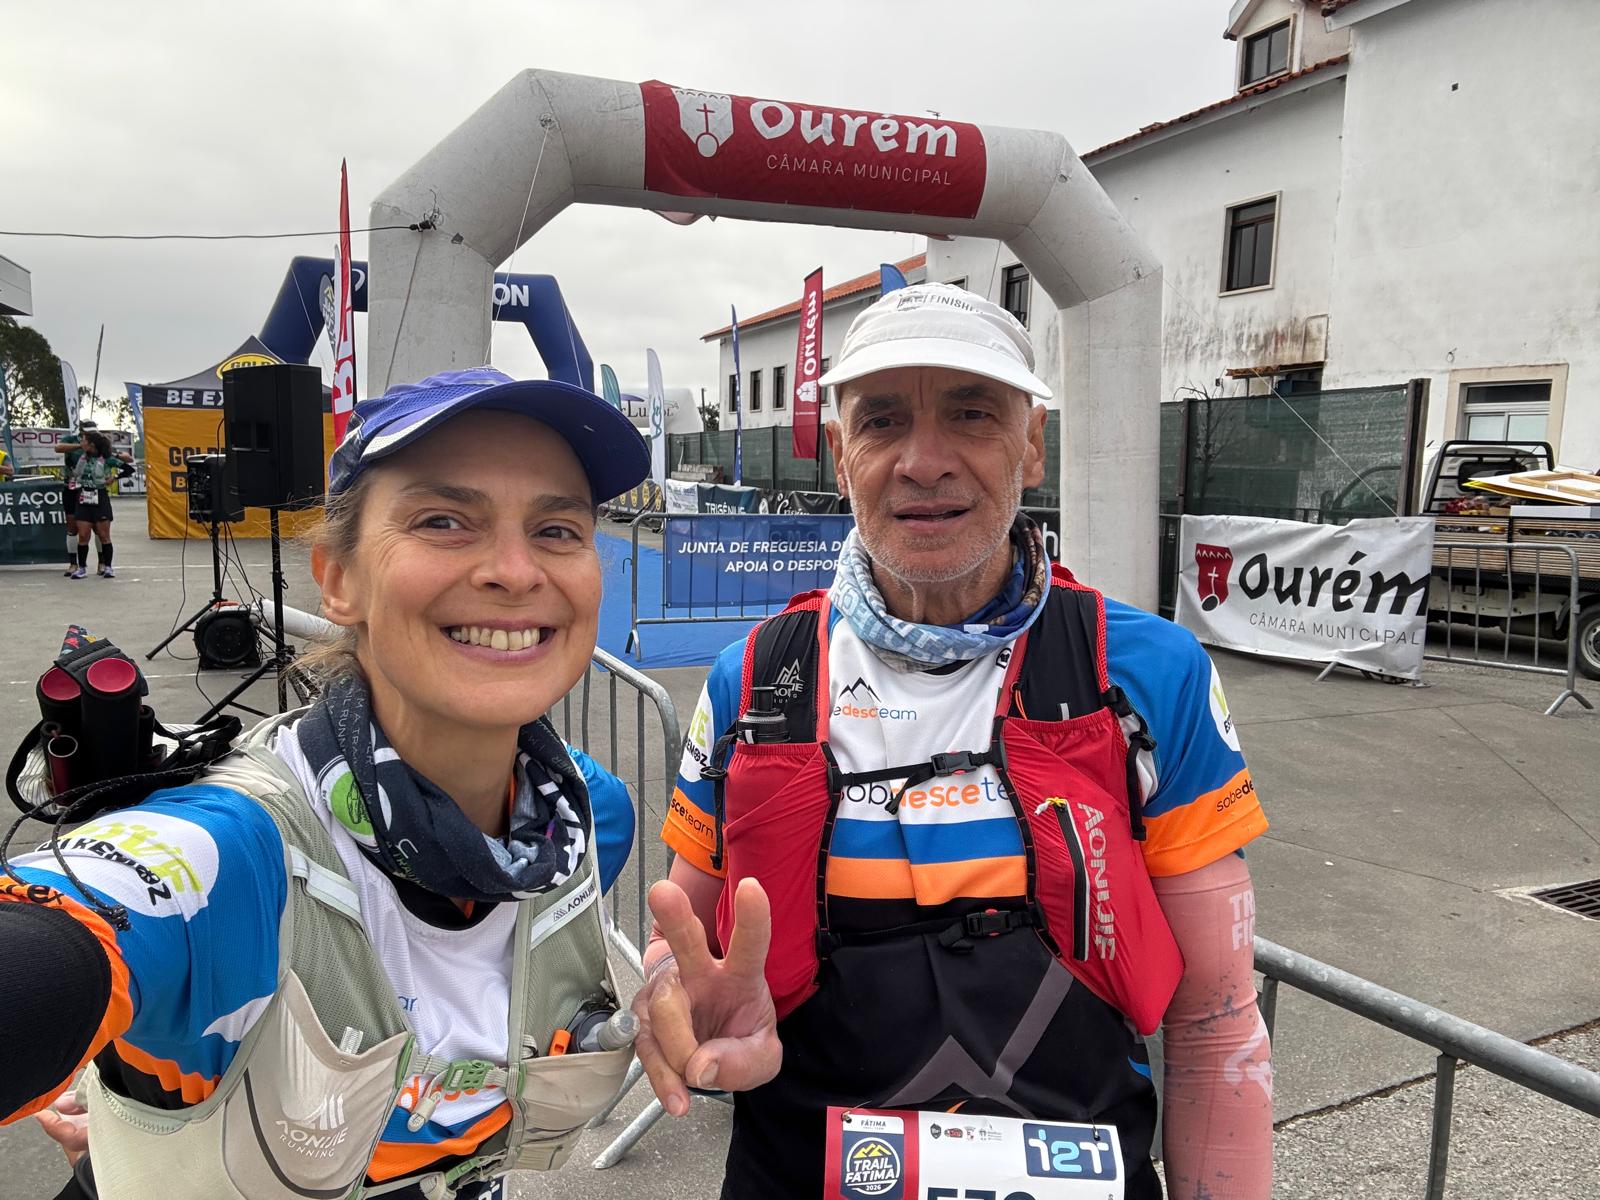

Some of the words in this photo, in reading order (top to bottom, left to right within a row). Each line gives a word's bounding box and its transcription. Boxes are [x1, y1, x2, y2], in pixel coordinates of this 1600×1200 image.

[750, 100, 957, 157] Ourém
[767, 154, 845, 176] CÂMARA
[854, 163, 951, 186] MUNICIPAL
[167, 389, 194, 405] BE
[18, 491, 63, 509] AÇO!
[20, 511, 45, 525] EM
[679, 541, 725, 554] JUNTA
[730, 541, 749, 553] DE
[753, 540, 830, 554] FREGUESIA
[832, 540, 844, 552] D
[725, 560, 769, 573] APOIA
[773, 560, 784, 571] O
[1238, 550, 1432, 617] Ourém
[1250, 612, 1306, 634] CÂMARA
[1312, 622, 1420, 646] MUNICIPAL
[279, 1134, 335, 1158] RUNNING
[854, 1157, 893, 1172] TRAIL
